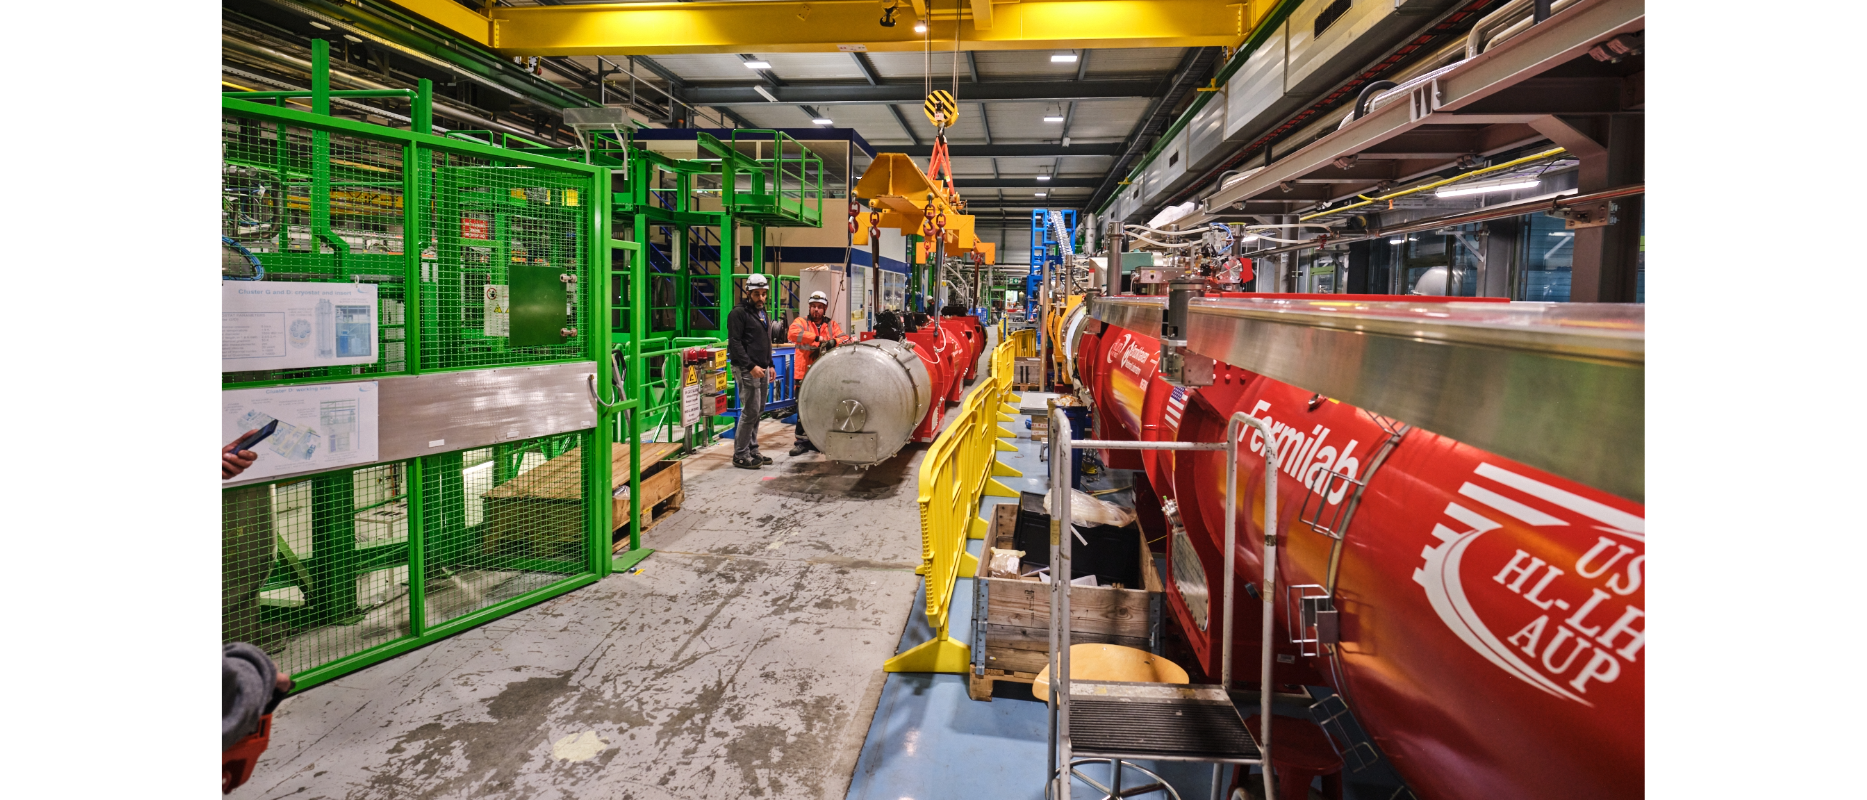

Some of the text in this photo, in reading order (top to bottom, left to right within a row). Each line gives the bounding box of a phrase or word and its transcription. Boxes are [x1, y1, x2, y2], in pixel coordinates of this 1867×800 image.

[294, 289, 320, 297] cryostat
[1238, 399, 1359, 505] Fermilab
[1575, 536, 1645, 595] US
[1507, 614, 1621, 693] AUP
